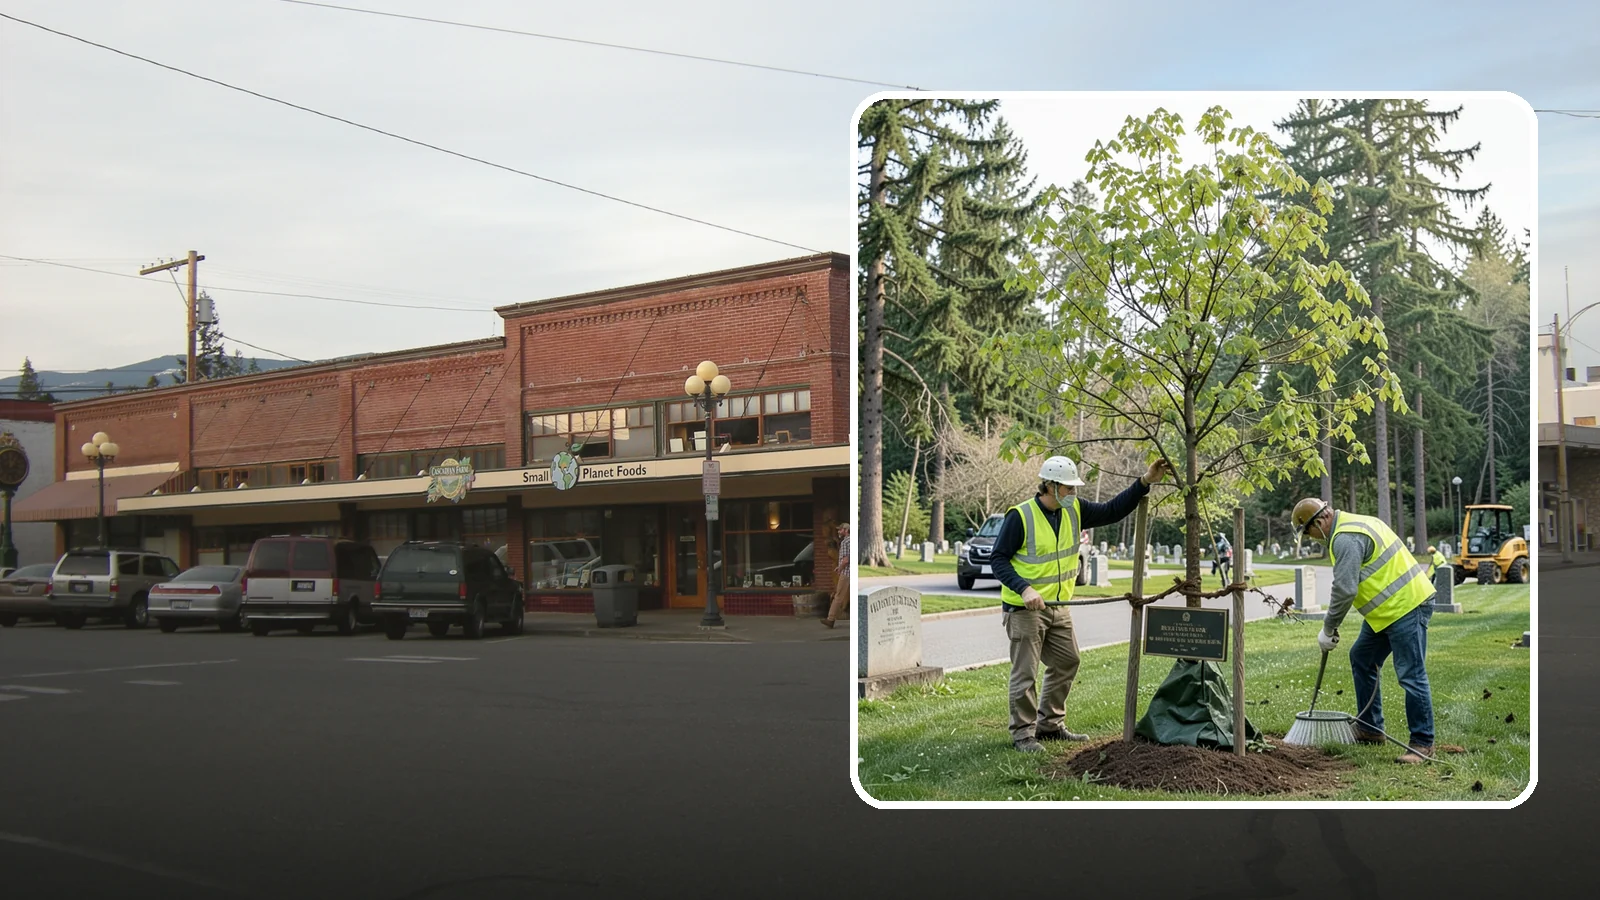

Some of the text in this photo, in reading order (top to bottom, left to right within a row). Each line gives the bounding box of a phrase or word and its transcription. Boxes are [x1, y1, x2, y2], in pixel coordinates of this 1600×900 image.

[523, 464, 647, 483] Small Planet Foods
